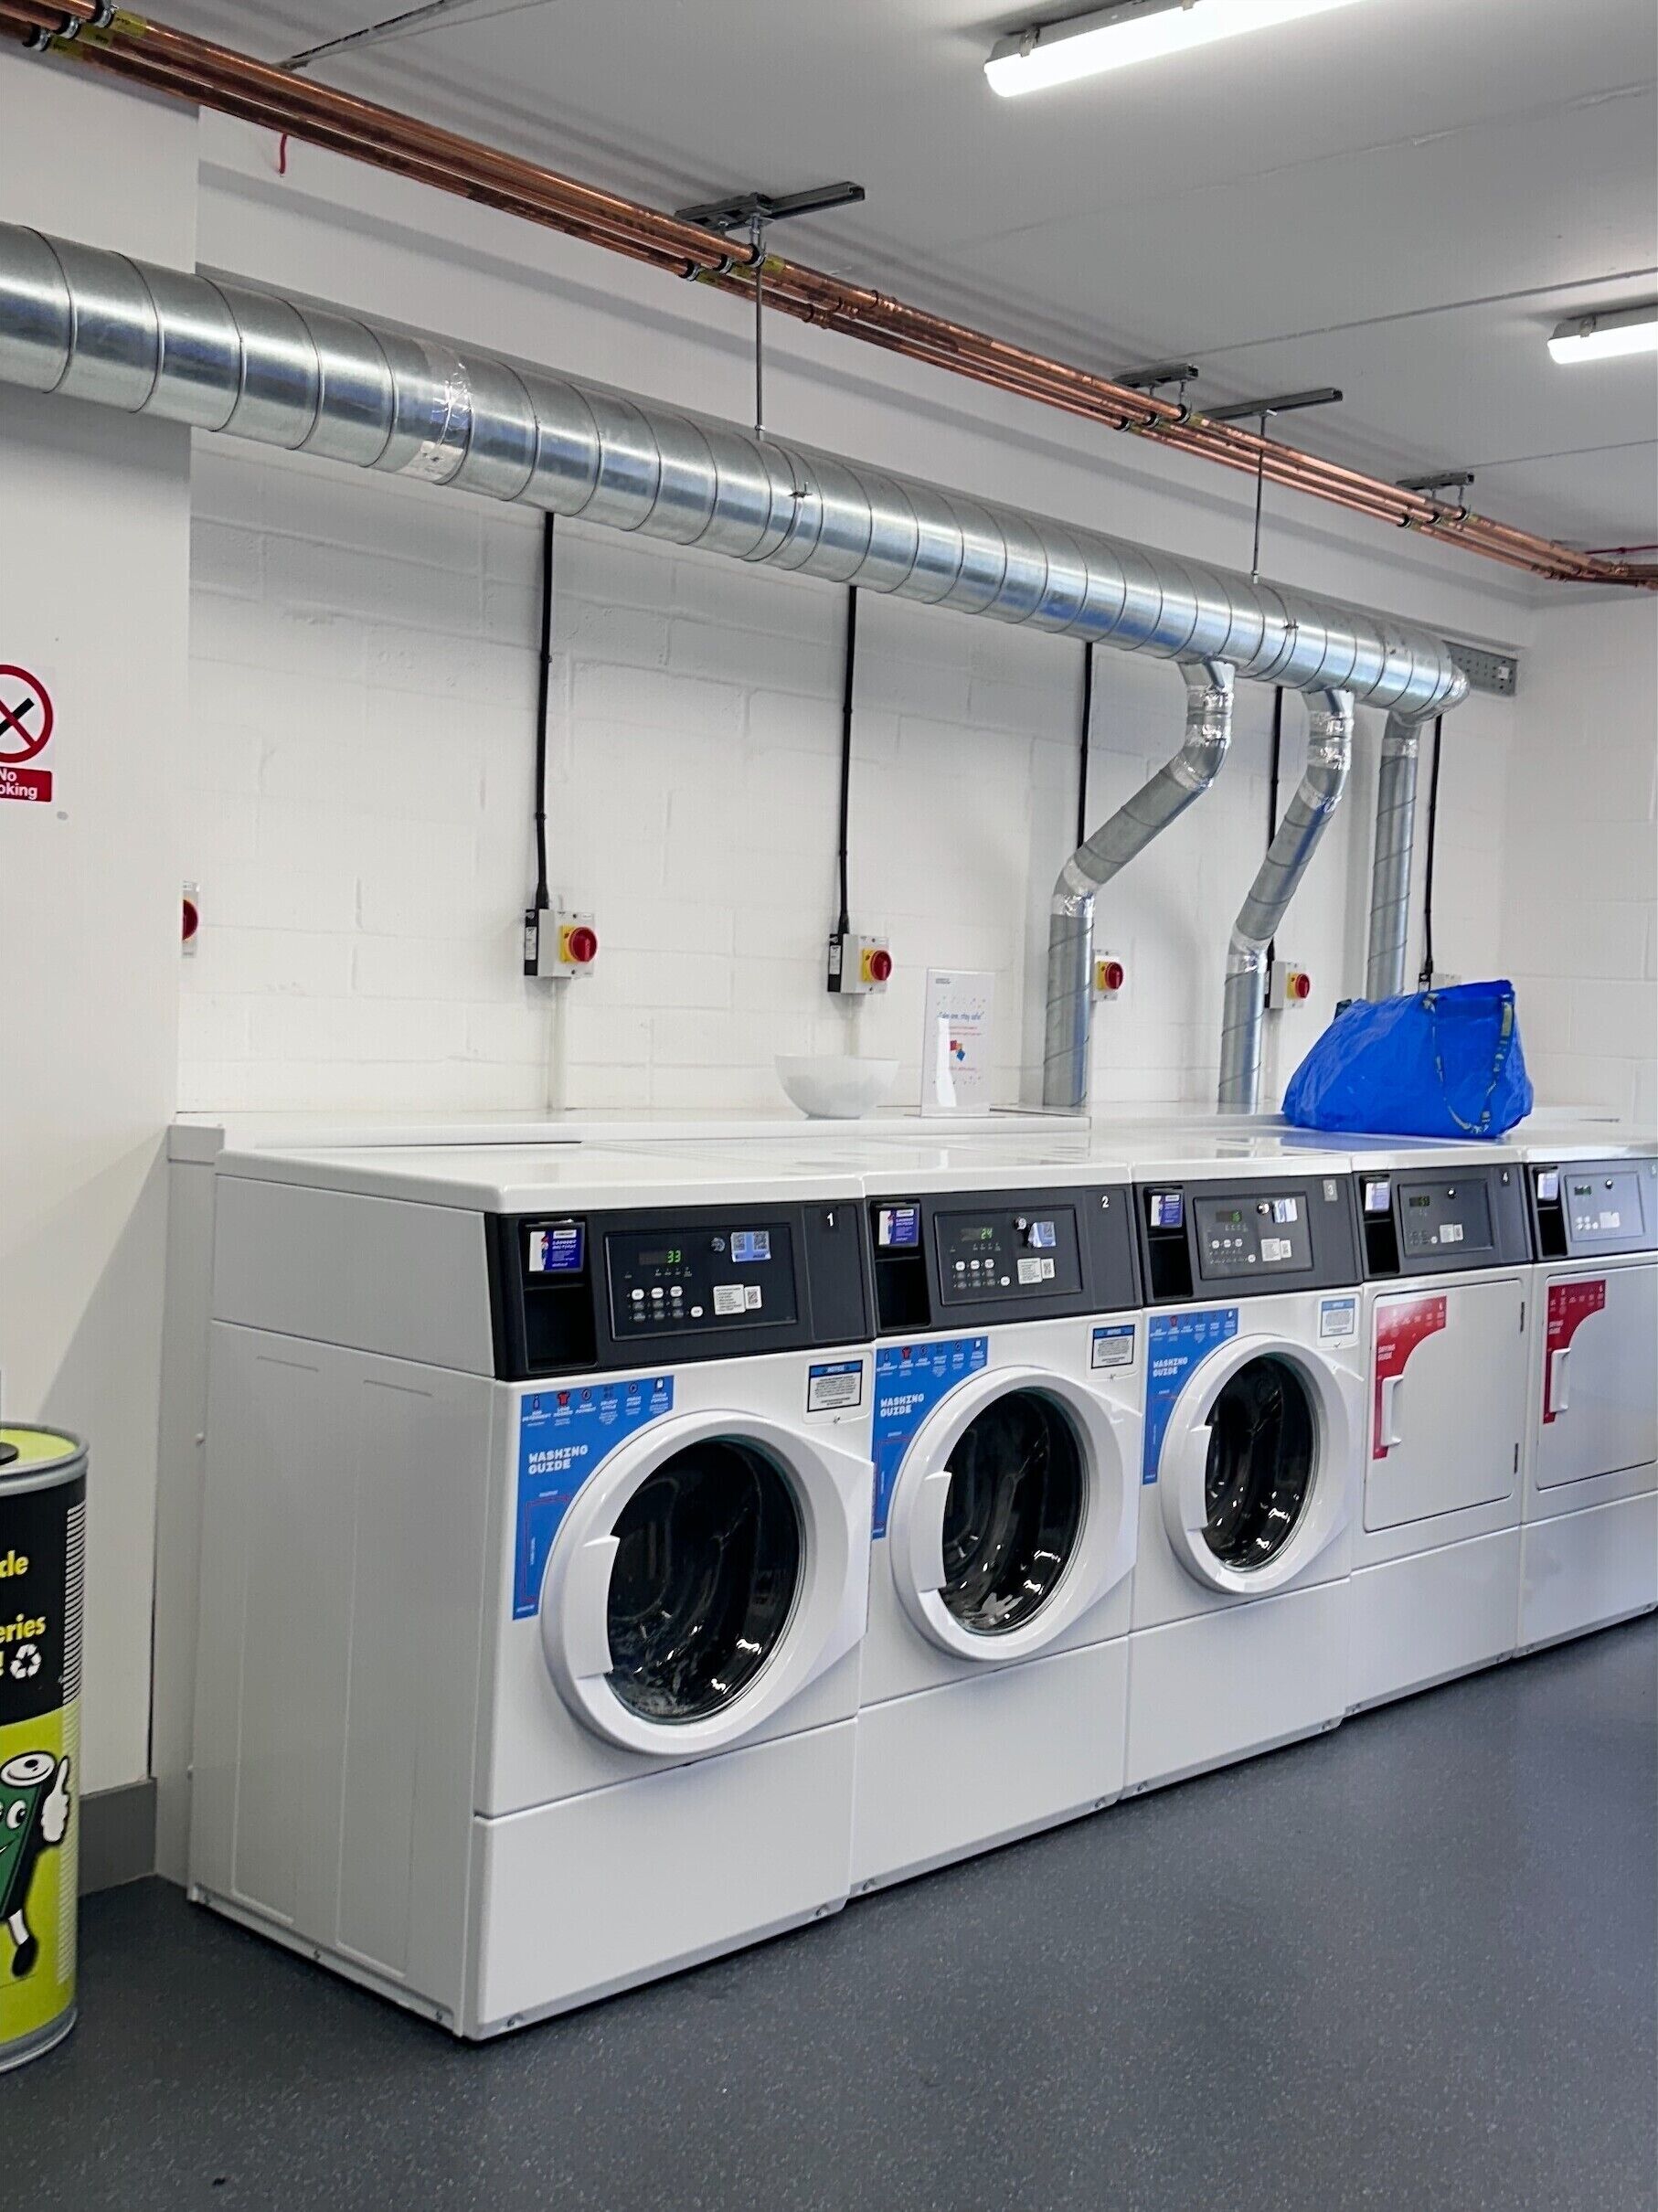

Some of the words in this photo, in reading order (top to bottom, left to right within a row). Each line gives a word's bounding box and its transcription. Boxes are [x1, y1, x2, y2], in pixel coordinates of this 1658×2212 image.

[1327, 1185, 1334, 1195] 3
[1101, 1196, 1110, 1208] 2
[826, 1212, 834, 1227] 1
[981, 1228, 993, 1239] 24
[667, 1250, 681, 1264] 33
[529, 1444, 589, 1463] WASHING
